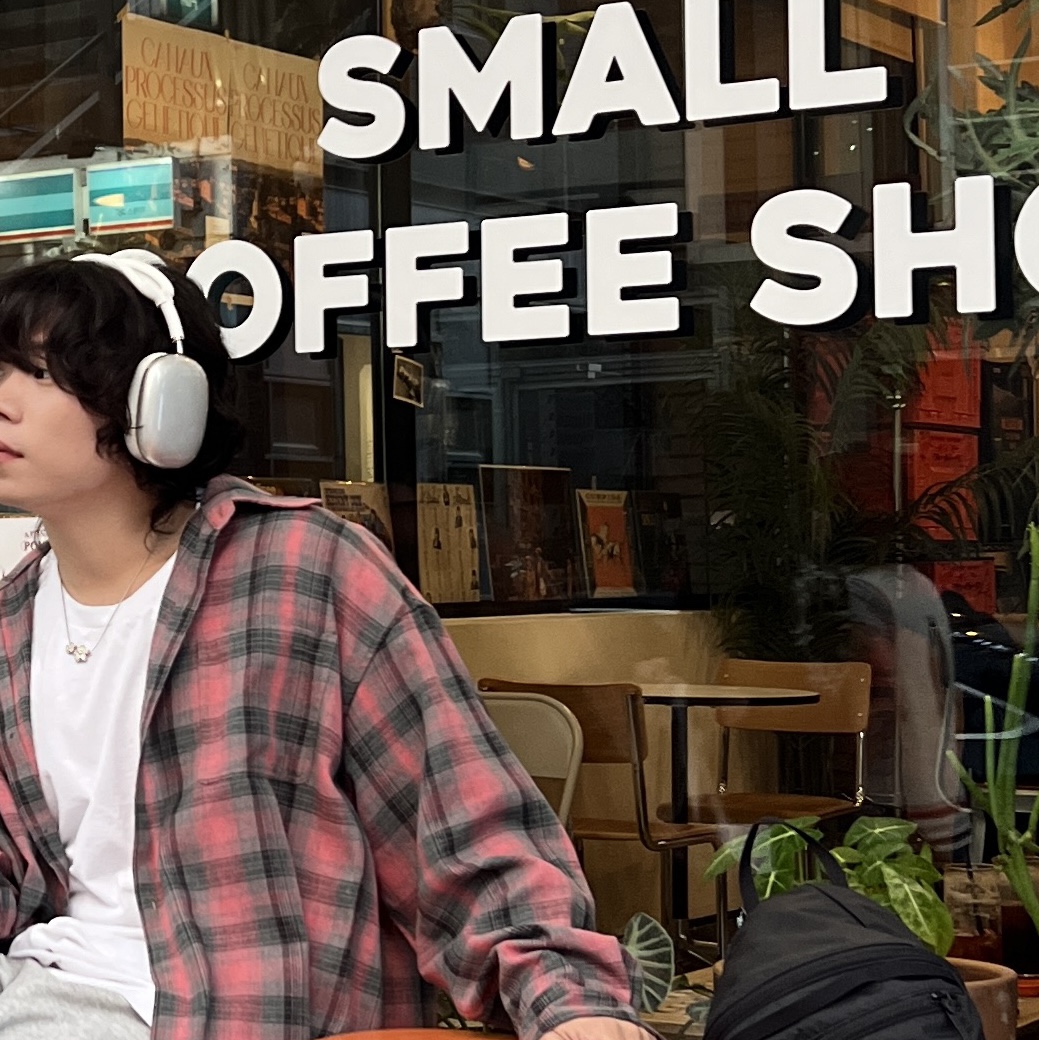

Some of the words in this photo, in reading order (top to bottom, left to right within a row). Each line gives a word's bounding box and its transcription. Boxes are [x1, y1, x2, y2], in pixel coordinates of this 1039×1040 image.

[317, 0, 888, 160] SMALL
[188, 202, 681, 360] OFFEE
[750, 175, 1039, 326] SH
